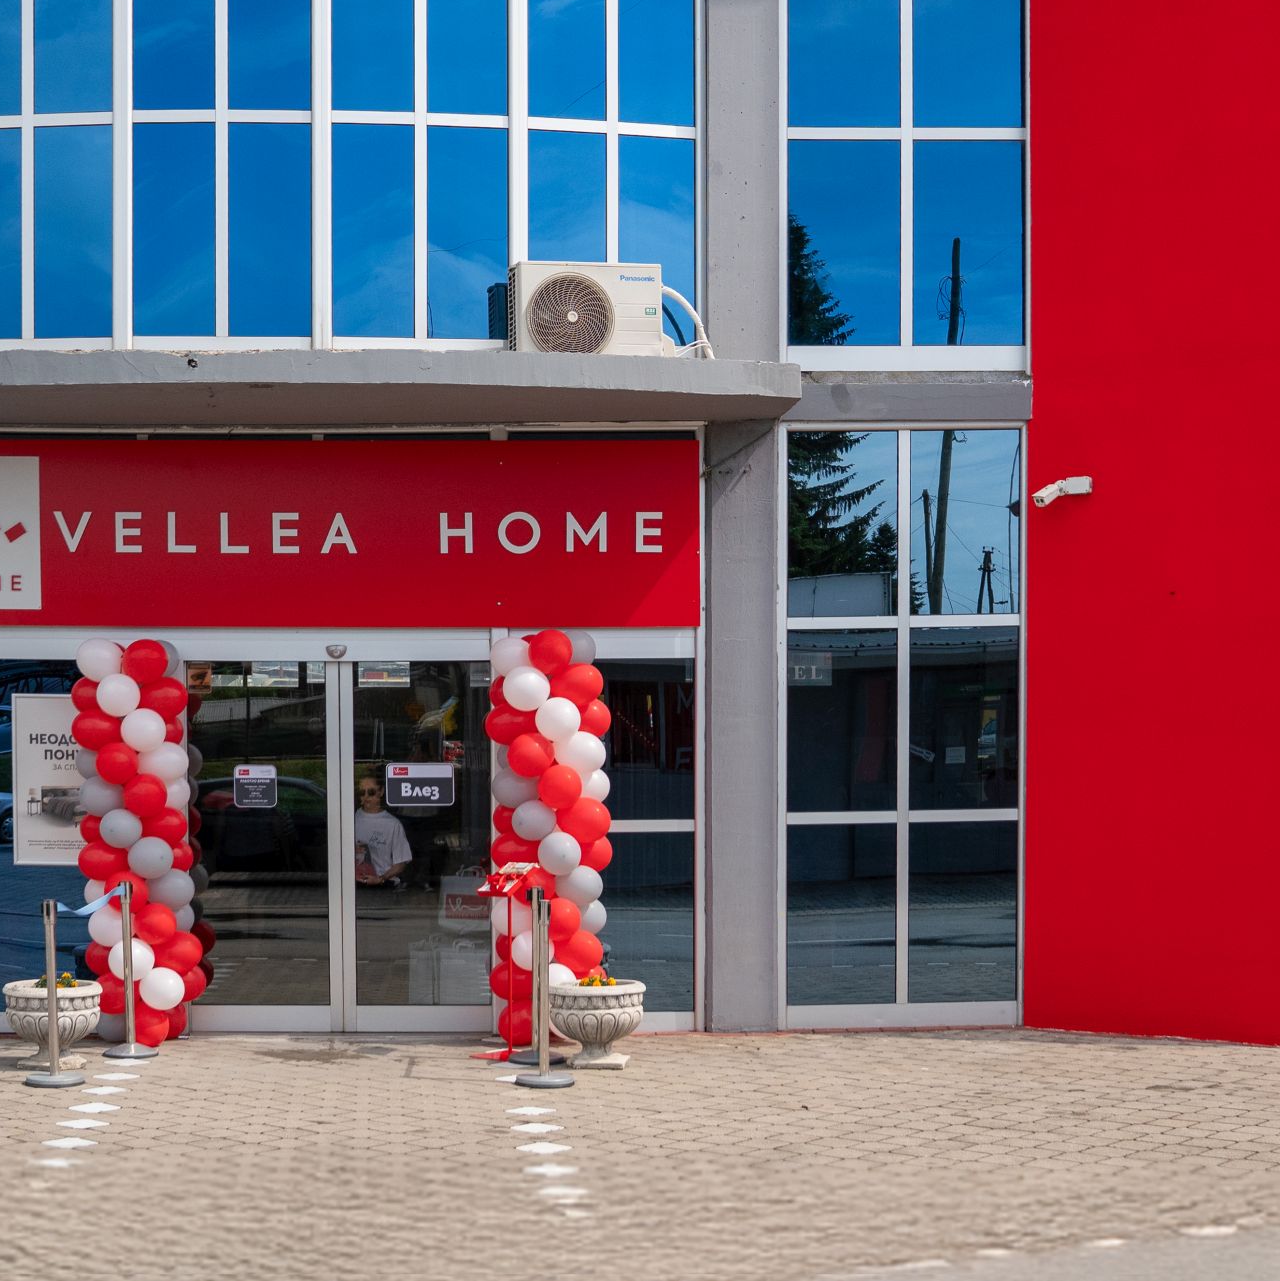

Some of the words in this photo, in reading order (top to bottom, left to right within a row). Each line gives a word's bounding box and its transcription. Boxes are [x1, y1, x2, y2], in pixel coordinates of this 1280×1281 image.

[619, 274, 655, 282] Panasonic
[53, 511, 358, 554] VELLEA
[439, 511, 663, 554] HOME
[44, 749, 79, 761] ПОН
[401, 782, 440, 800] Влез
